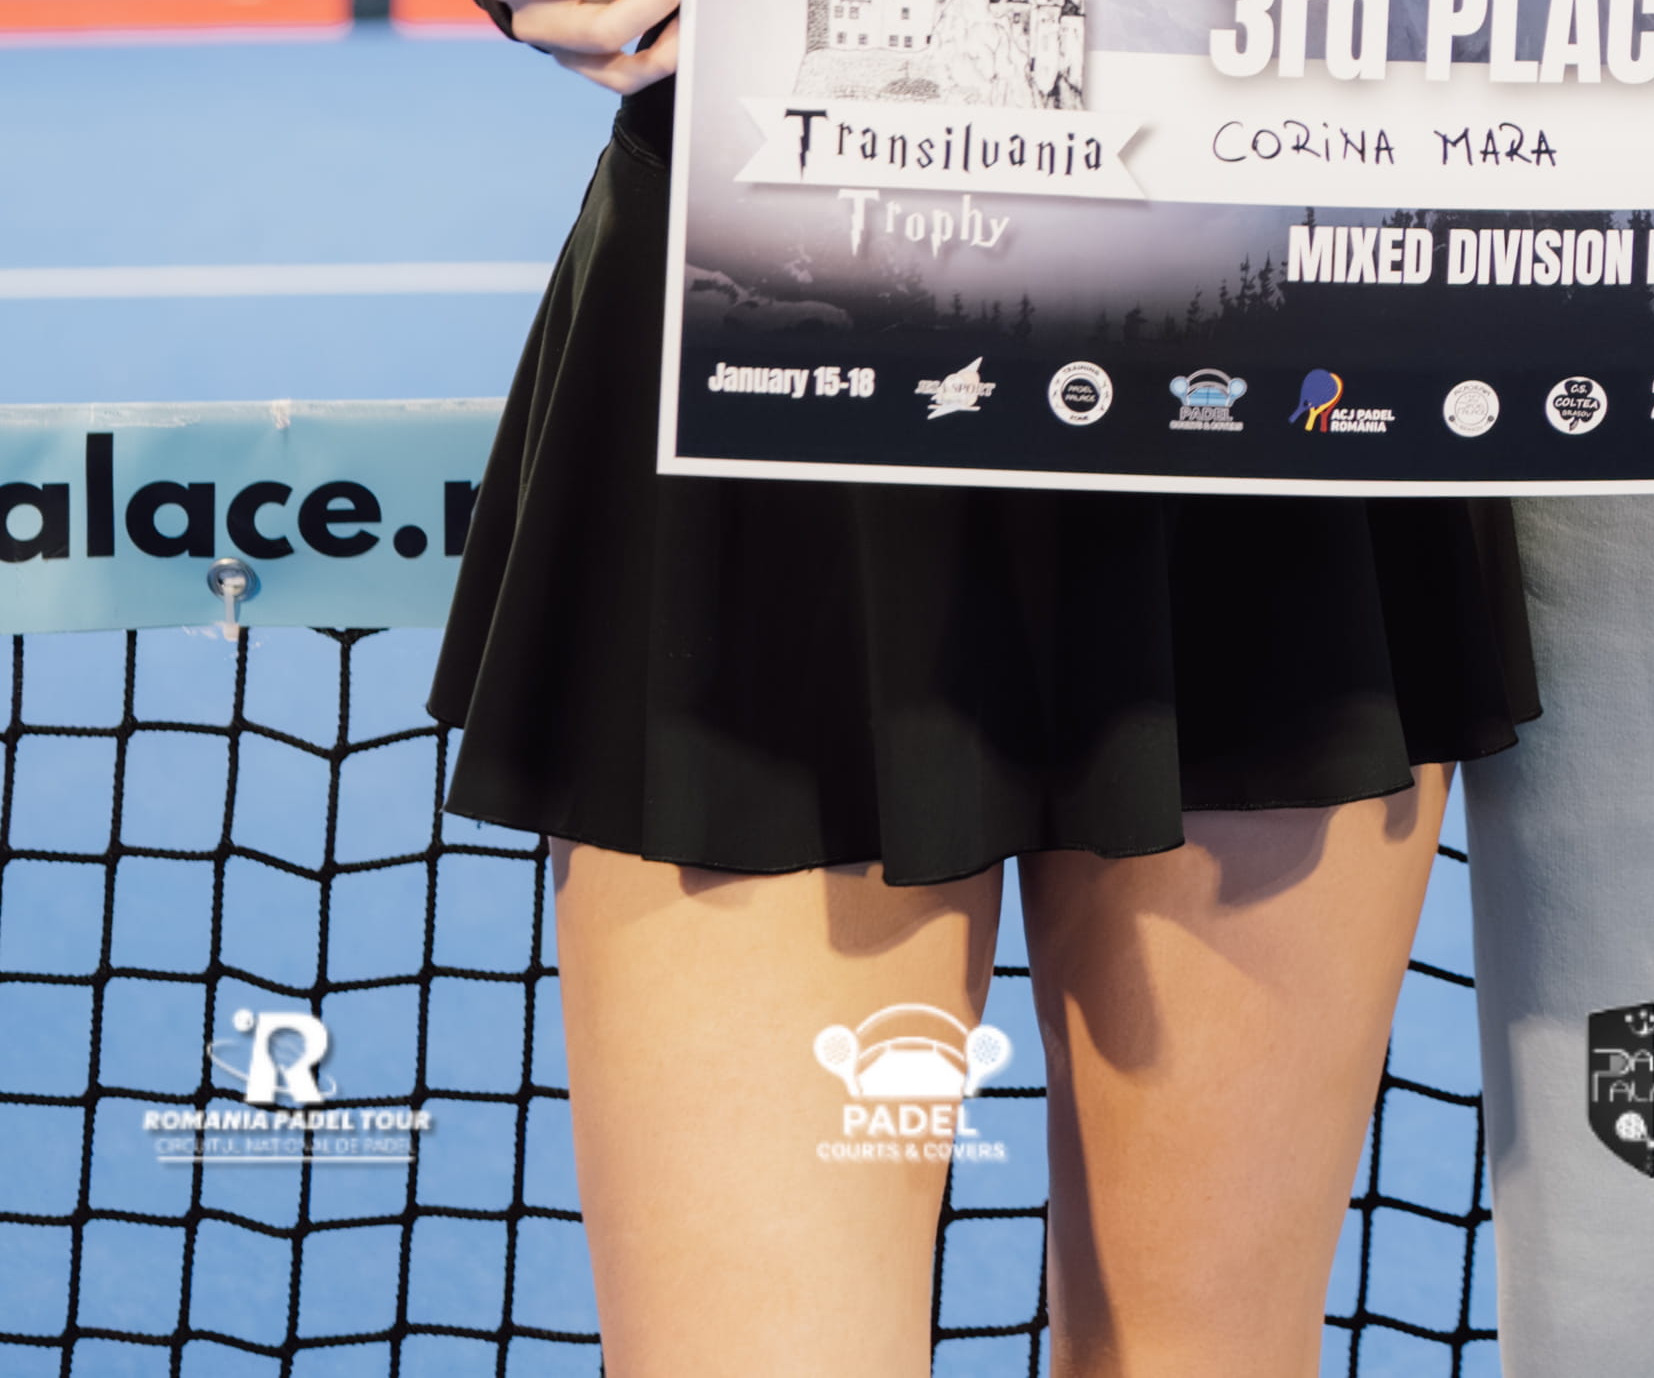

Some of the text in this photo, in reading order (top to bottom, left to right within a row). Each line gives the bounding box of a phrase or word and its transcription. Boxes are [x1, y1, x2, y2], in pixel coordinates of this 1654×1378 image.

[784, 108, 1104, 179] Transilvania
[1433, 122, 1558, 168] MARA
[837, 188, 1011, 259] Trophy
[1287, 225, 1433, 284] MIXED
[1447, 228, 1635, 286] DIVISION
[708, 361, 876, 398] January 15-18
[1179, 406, 1234, 422] PADEL
[1331, 408, 1396, 421] ACJ PADEL
[1554, 397, 1599, 410] COLTEA
